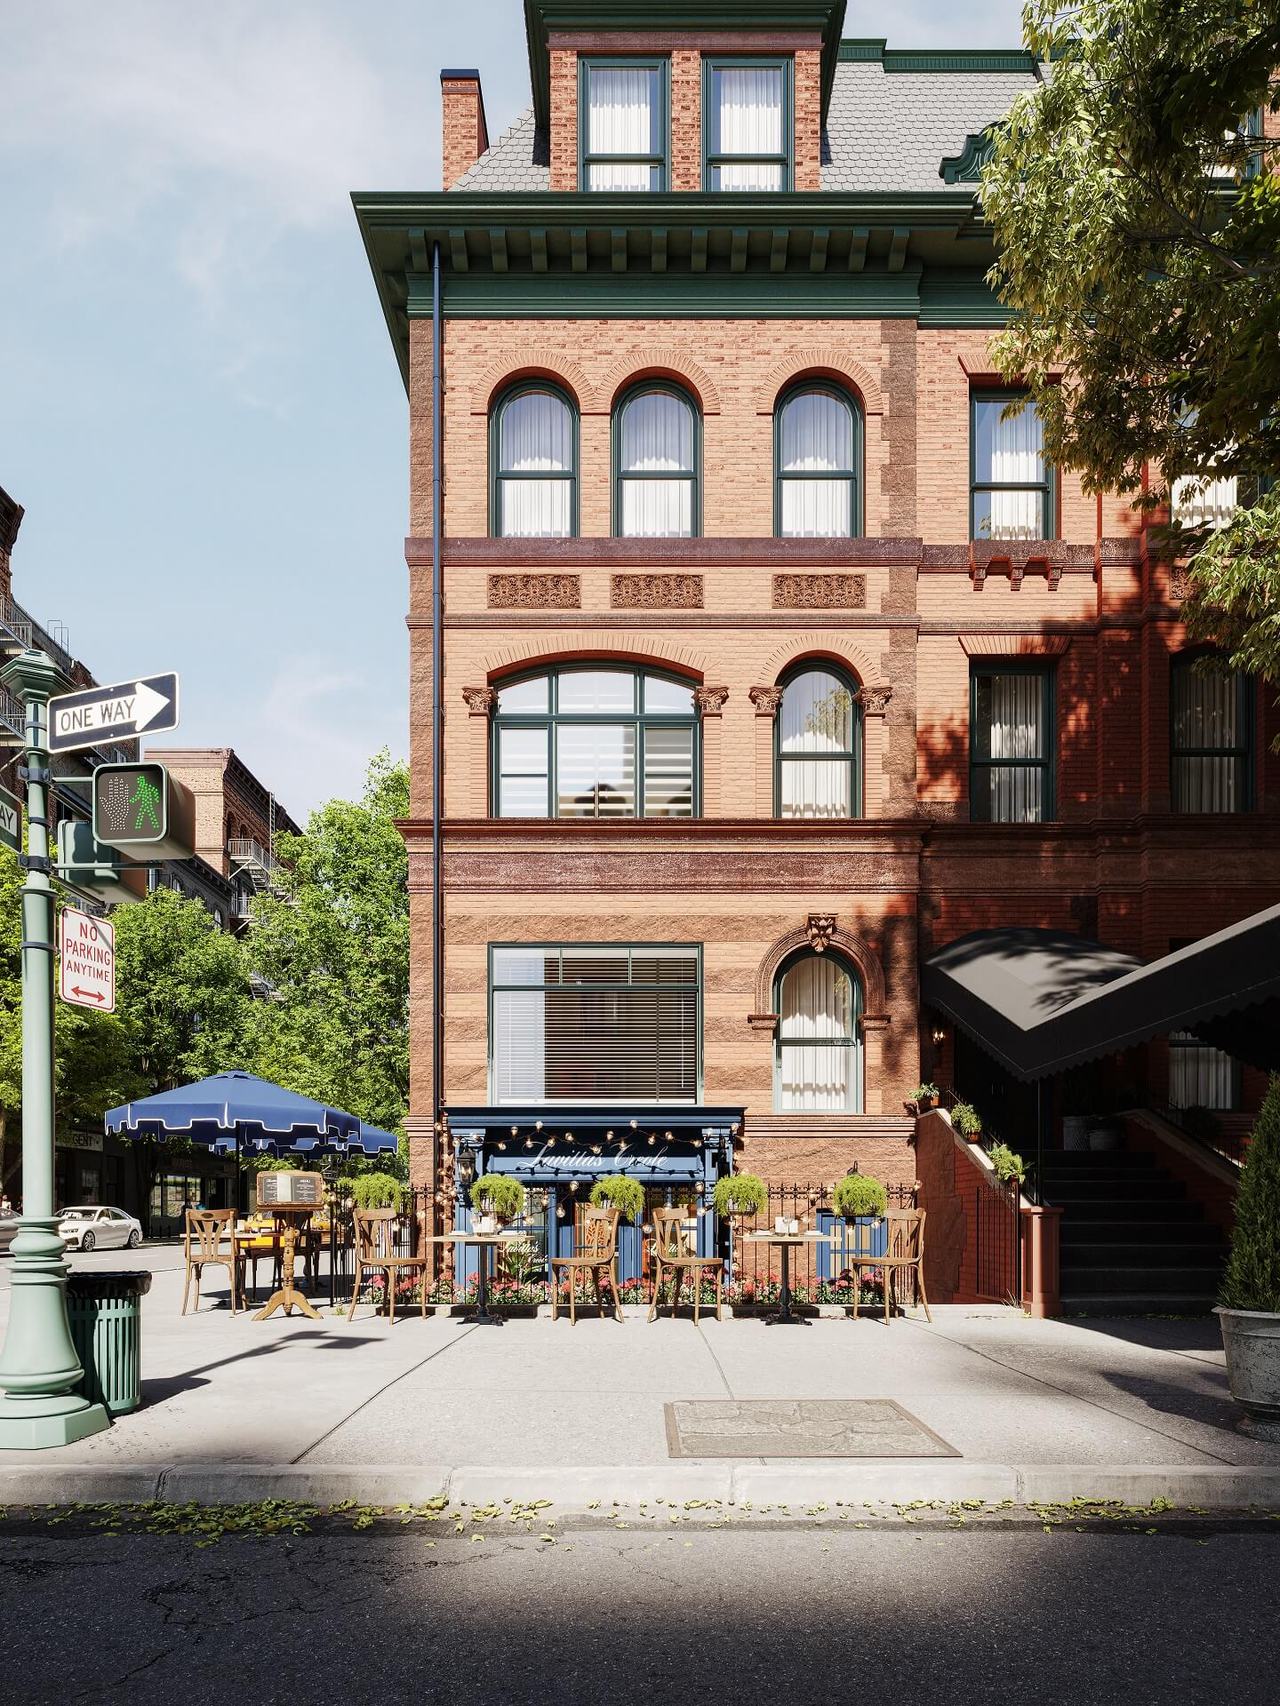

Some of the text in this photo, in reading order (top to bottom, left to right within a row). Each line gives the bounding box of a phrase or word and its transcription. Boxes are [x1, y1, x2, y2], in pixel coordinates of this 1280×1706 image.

[61, 698, 135, 731] ONE WAY
[0, 804, 14, 830] AY
[80, 922, 98, 942] NO
[66, 938, 110, 966] PARKING
[66, 959, 110, 982] ANYTIME
